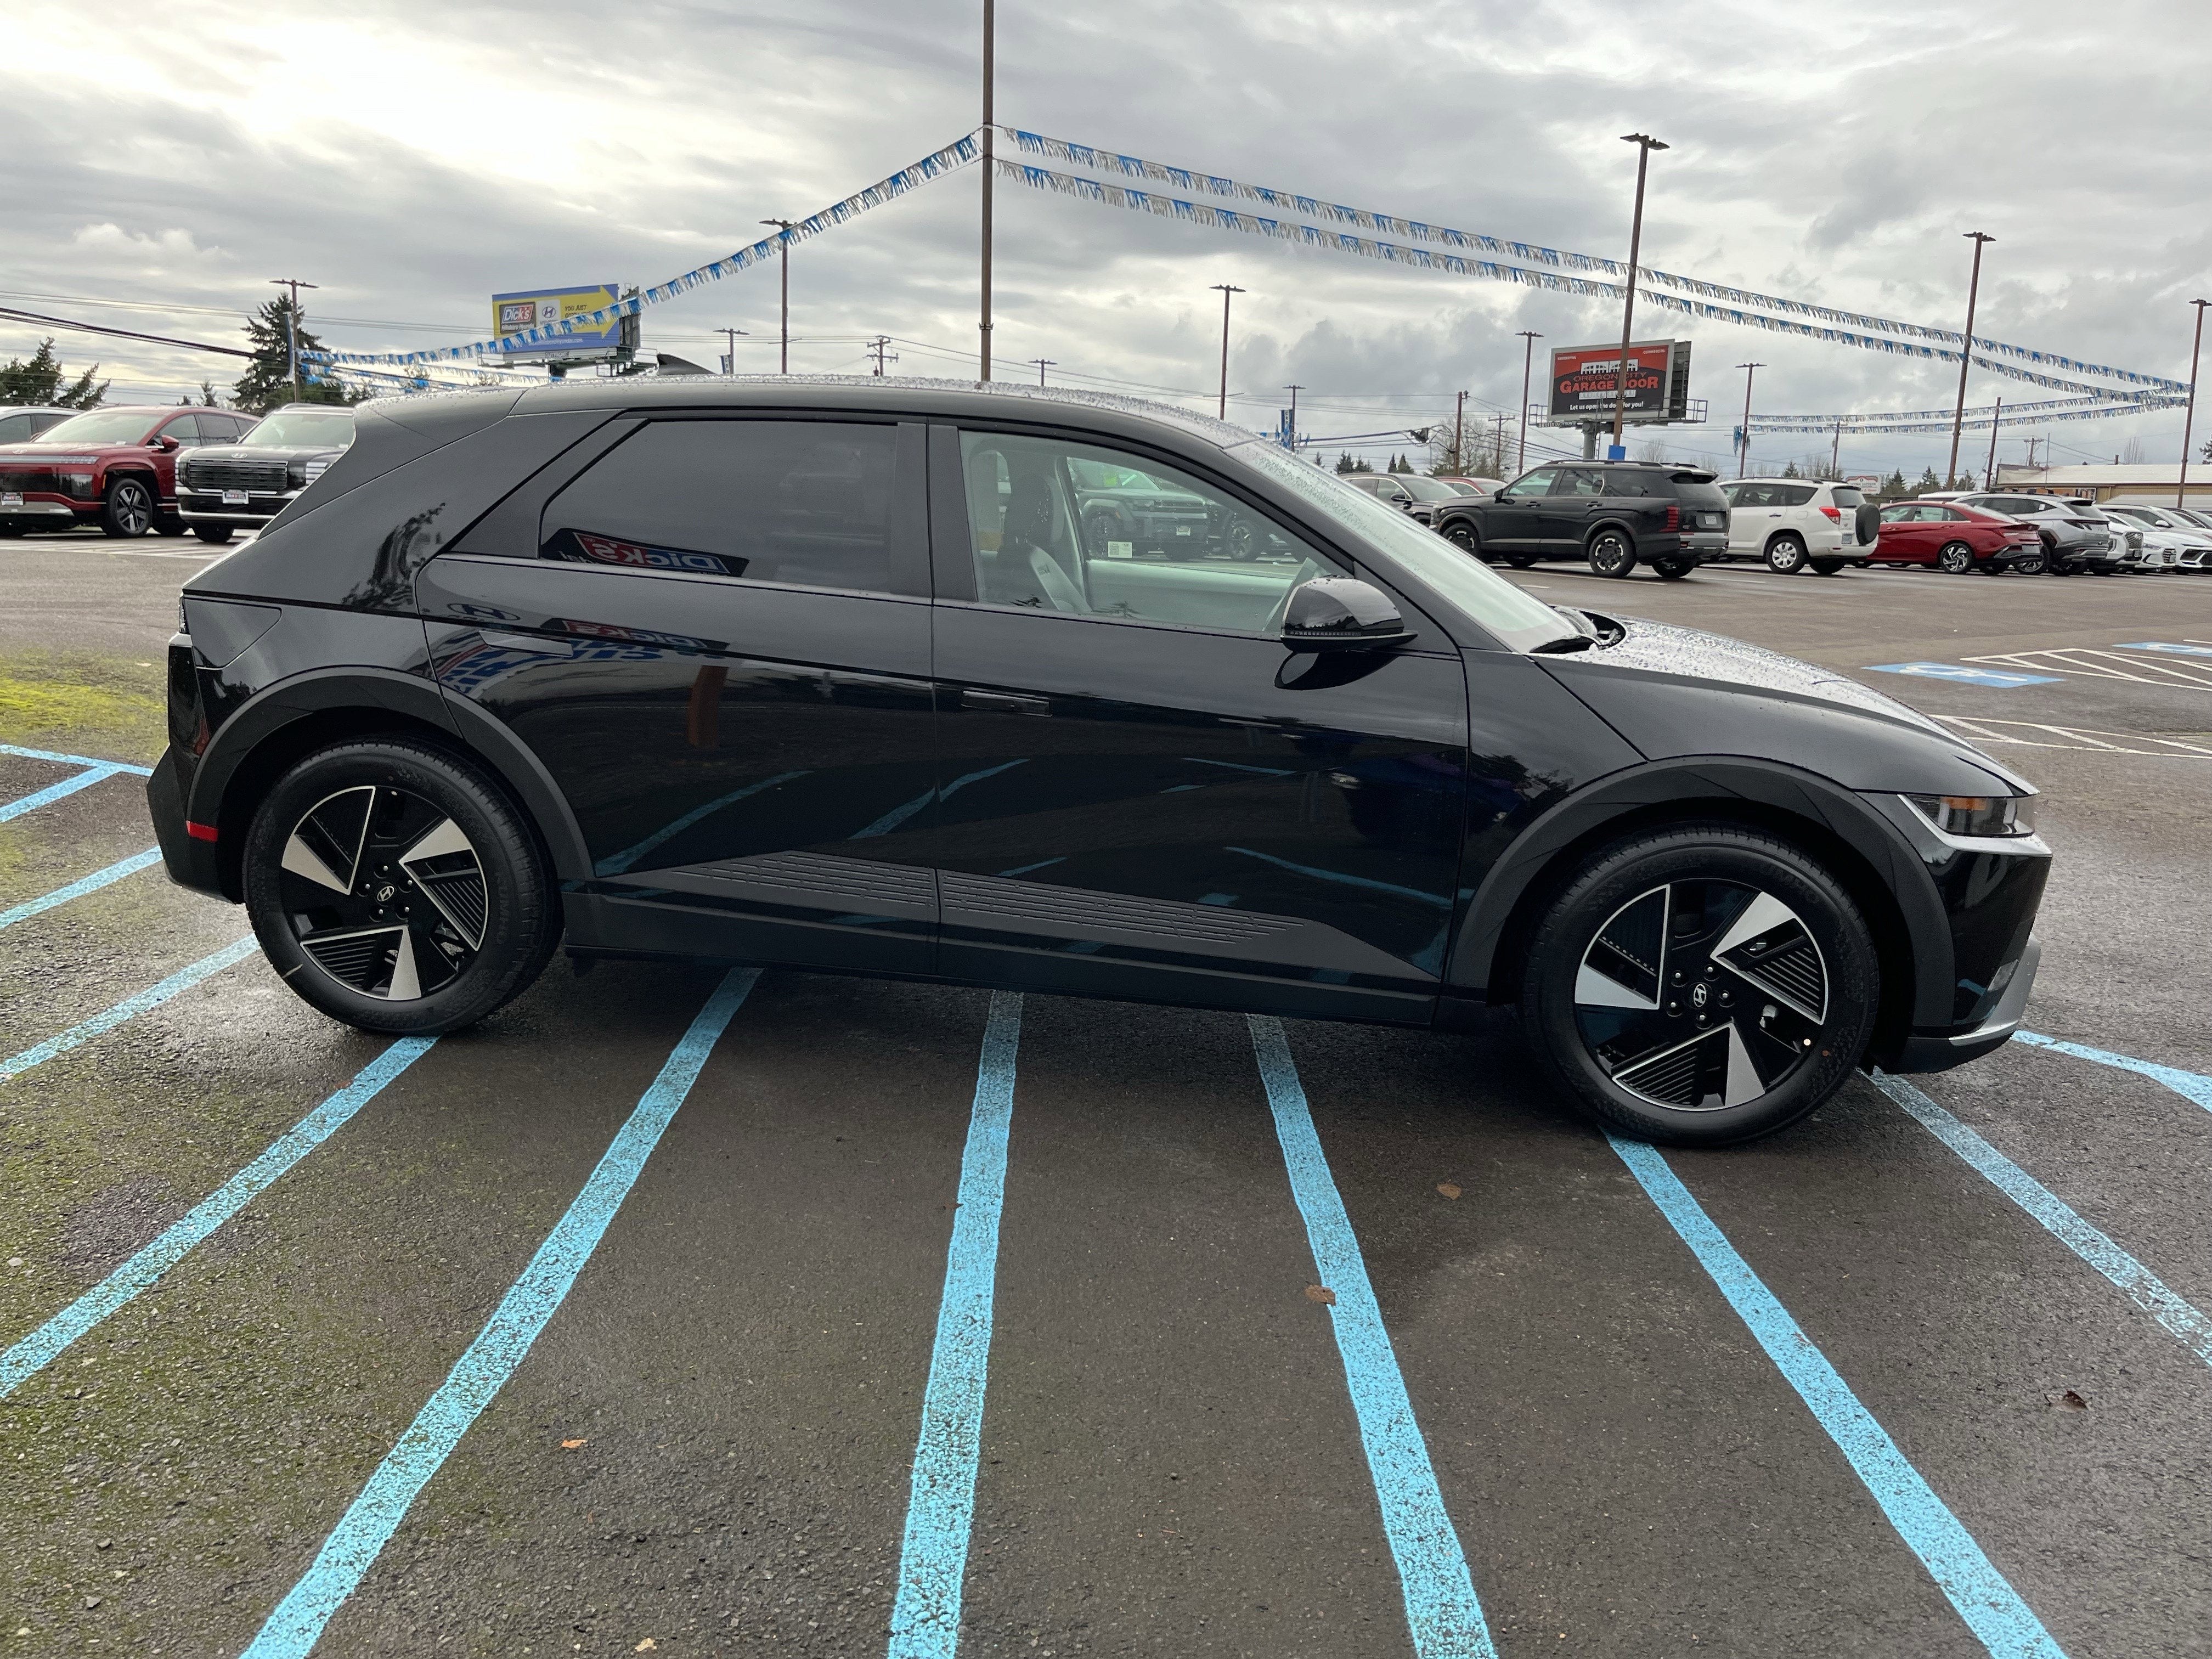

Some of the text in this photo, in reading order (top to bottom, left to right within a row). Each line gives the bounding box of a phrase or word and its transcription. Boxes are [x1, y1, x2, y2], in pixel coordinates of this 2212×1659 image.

[504, 307, 531, 321] Dick's
[1573, 374, 1618, 382] OREGON
[1560, 376, 1659, 394] GARAGE OOR
[1632, 400, 1644, 409] you!
